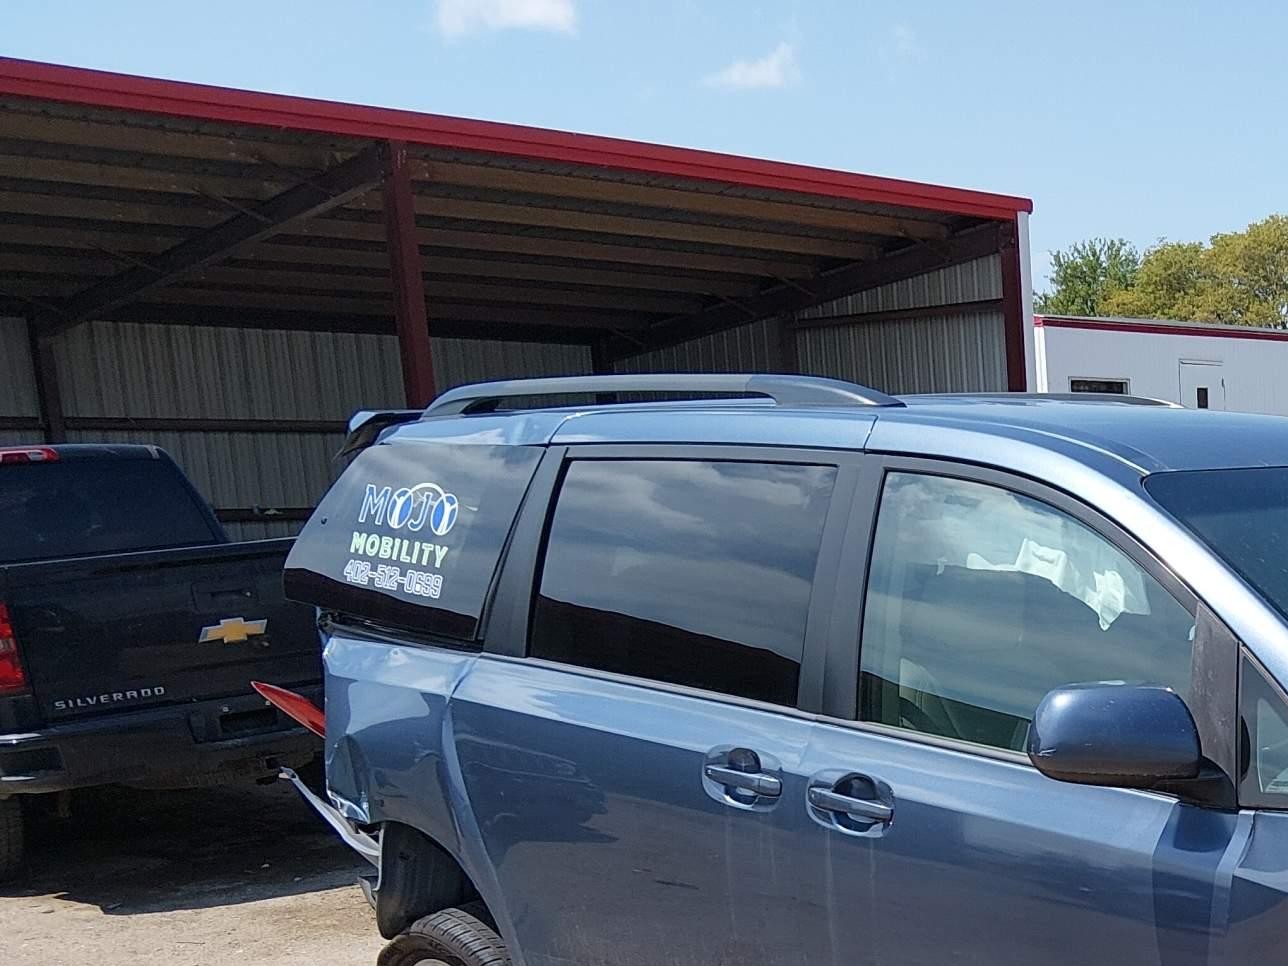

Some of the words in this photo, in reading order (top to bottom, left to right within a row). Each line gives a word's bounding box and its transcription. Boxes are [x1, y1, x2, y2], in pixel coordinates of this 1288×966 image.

[358, 483, 459, 536] MOJO
[350, 531, 449, 569] MOBILITY
[343, 559, 443, 599] 402-512-0699
[54, 685, 166, 711] SILVERADO
